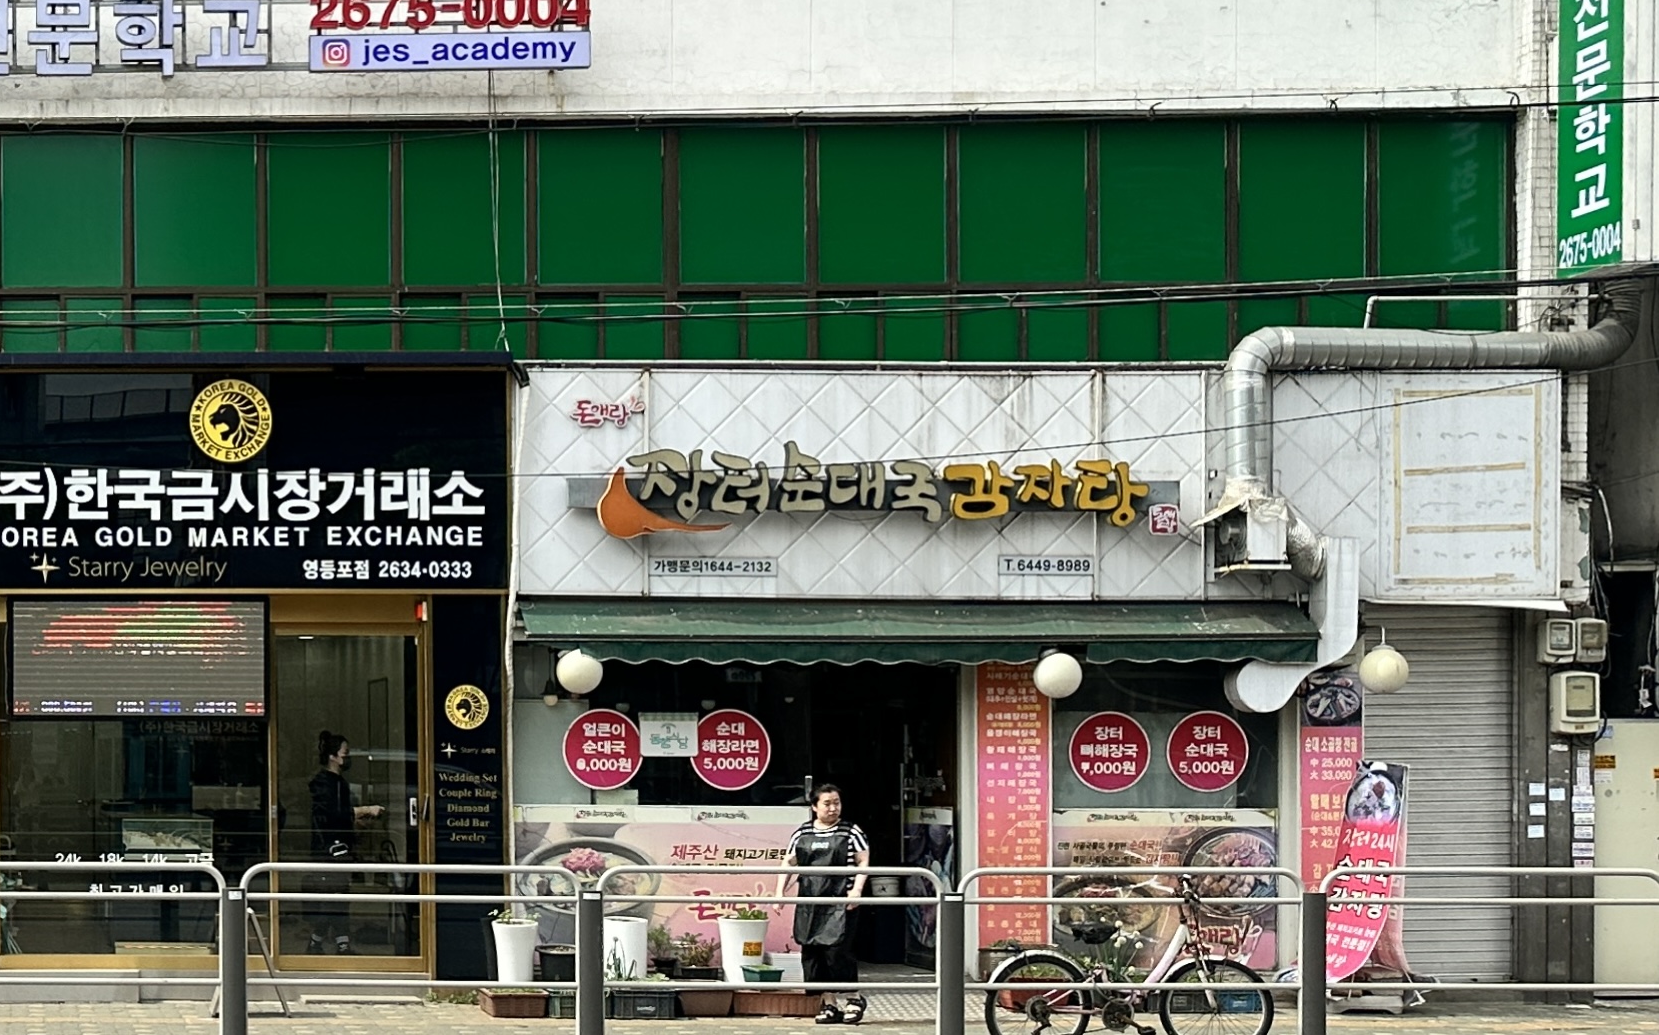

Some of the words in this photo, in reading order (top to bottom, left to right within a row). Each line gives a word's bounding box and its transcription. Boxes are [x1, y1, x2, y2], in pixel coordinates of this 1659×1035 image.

[362, 36, 576, 65] jes_academy
[1559, 221, 1622, 268] 2675-0004
[198, 381, 235, 406] KOREA
[238, 382, 266, 407] GOLD
[191, 413, 223, 457] MARKET
[224, 413, 270, 460] EXCHANGE
[95, 527, 173, 548] GOLD
[187, 527, 310, 548] MARKET
[327, 526, 483, 547] EXCHANGE
[68, 556, 134, 582] Starry
[140, 556, 227, 582] Jewelry
[302, 559, 371, 580] 영등포점
[654, 559, 772, 574] 가맹문의1644-2132
[582, 723, 625, 737] 얼큰이
[716, 723, 745, 736] 순대
[1095, 726, 1123, 740] 장터
[1192, 726, 1221, 740] 장터
[582, 740, 626, 754] 순대국
[702, 739, 760, 754] 해장라면
[1184, 743, 1229, 757] 순대국
[1305, 737, 1319, 753] 순대
[703, 757, 759, 771] 5,000원
[1179, 761, 1235, 775] 5,000원
[439, 773, 480, 784] Wedding
[482, 773, 497, 782] Set
[1310, 770, 1319, 780] 大
[439, 788, 472, 798] Couple
[475, 788, 497, 799] Ring
[447, 804, 490, 812] Diamond
[1332, 794, 1345, 810] 보
[447, 818, 470, 827] Gold
[472, 818, 490, 827] Bar
[450, 833, 487, 844] Jewelry
[1310, 839, 1319, 848] 大
[1342, 828, 1370, 847] 장터
[1371, 833, 1395, 852] 24시
[671, 845, 719, 860] 제주산
